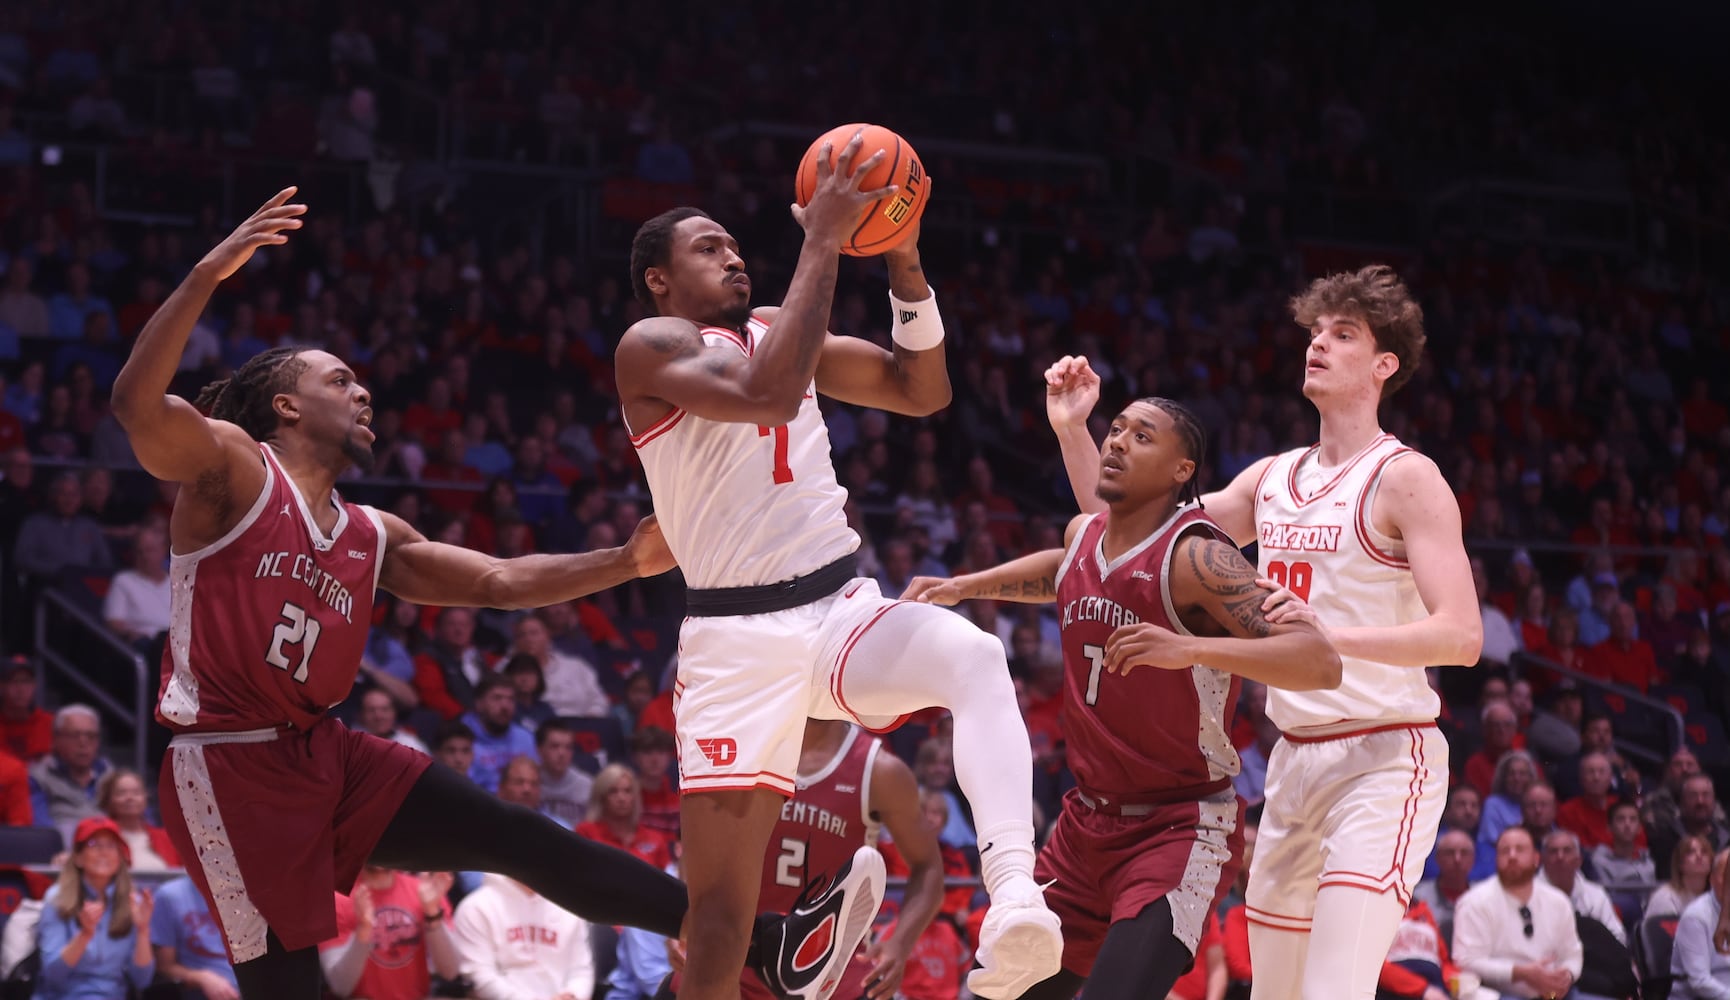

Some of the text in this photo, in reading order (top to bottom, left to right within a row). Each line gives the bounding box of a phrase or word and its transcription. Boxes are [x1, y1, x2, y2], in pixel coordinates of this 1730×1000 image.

[888, 158, 921, 224] ELITE
[1261, 521, 1342, 553] DAYTON
[254, 551, 353, 625] NC CENTRAL
[265, 601, 321, 684] 21
[1083, 643, 1104, 707] 7
[780, 799, 849, 838] ENTRAL
[775, 836, 807, 888] 2
